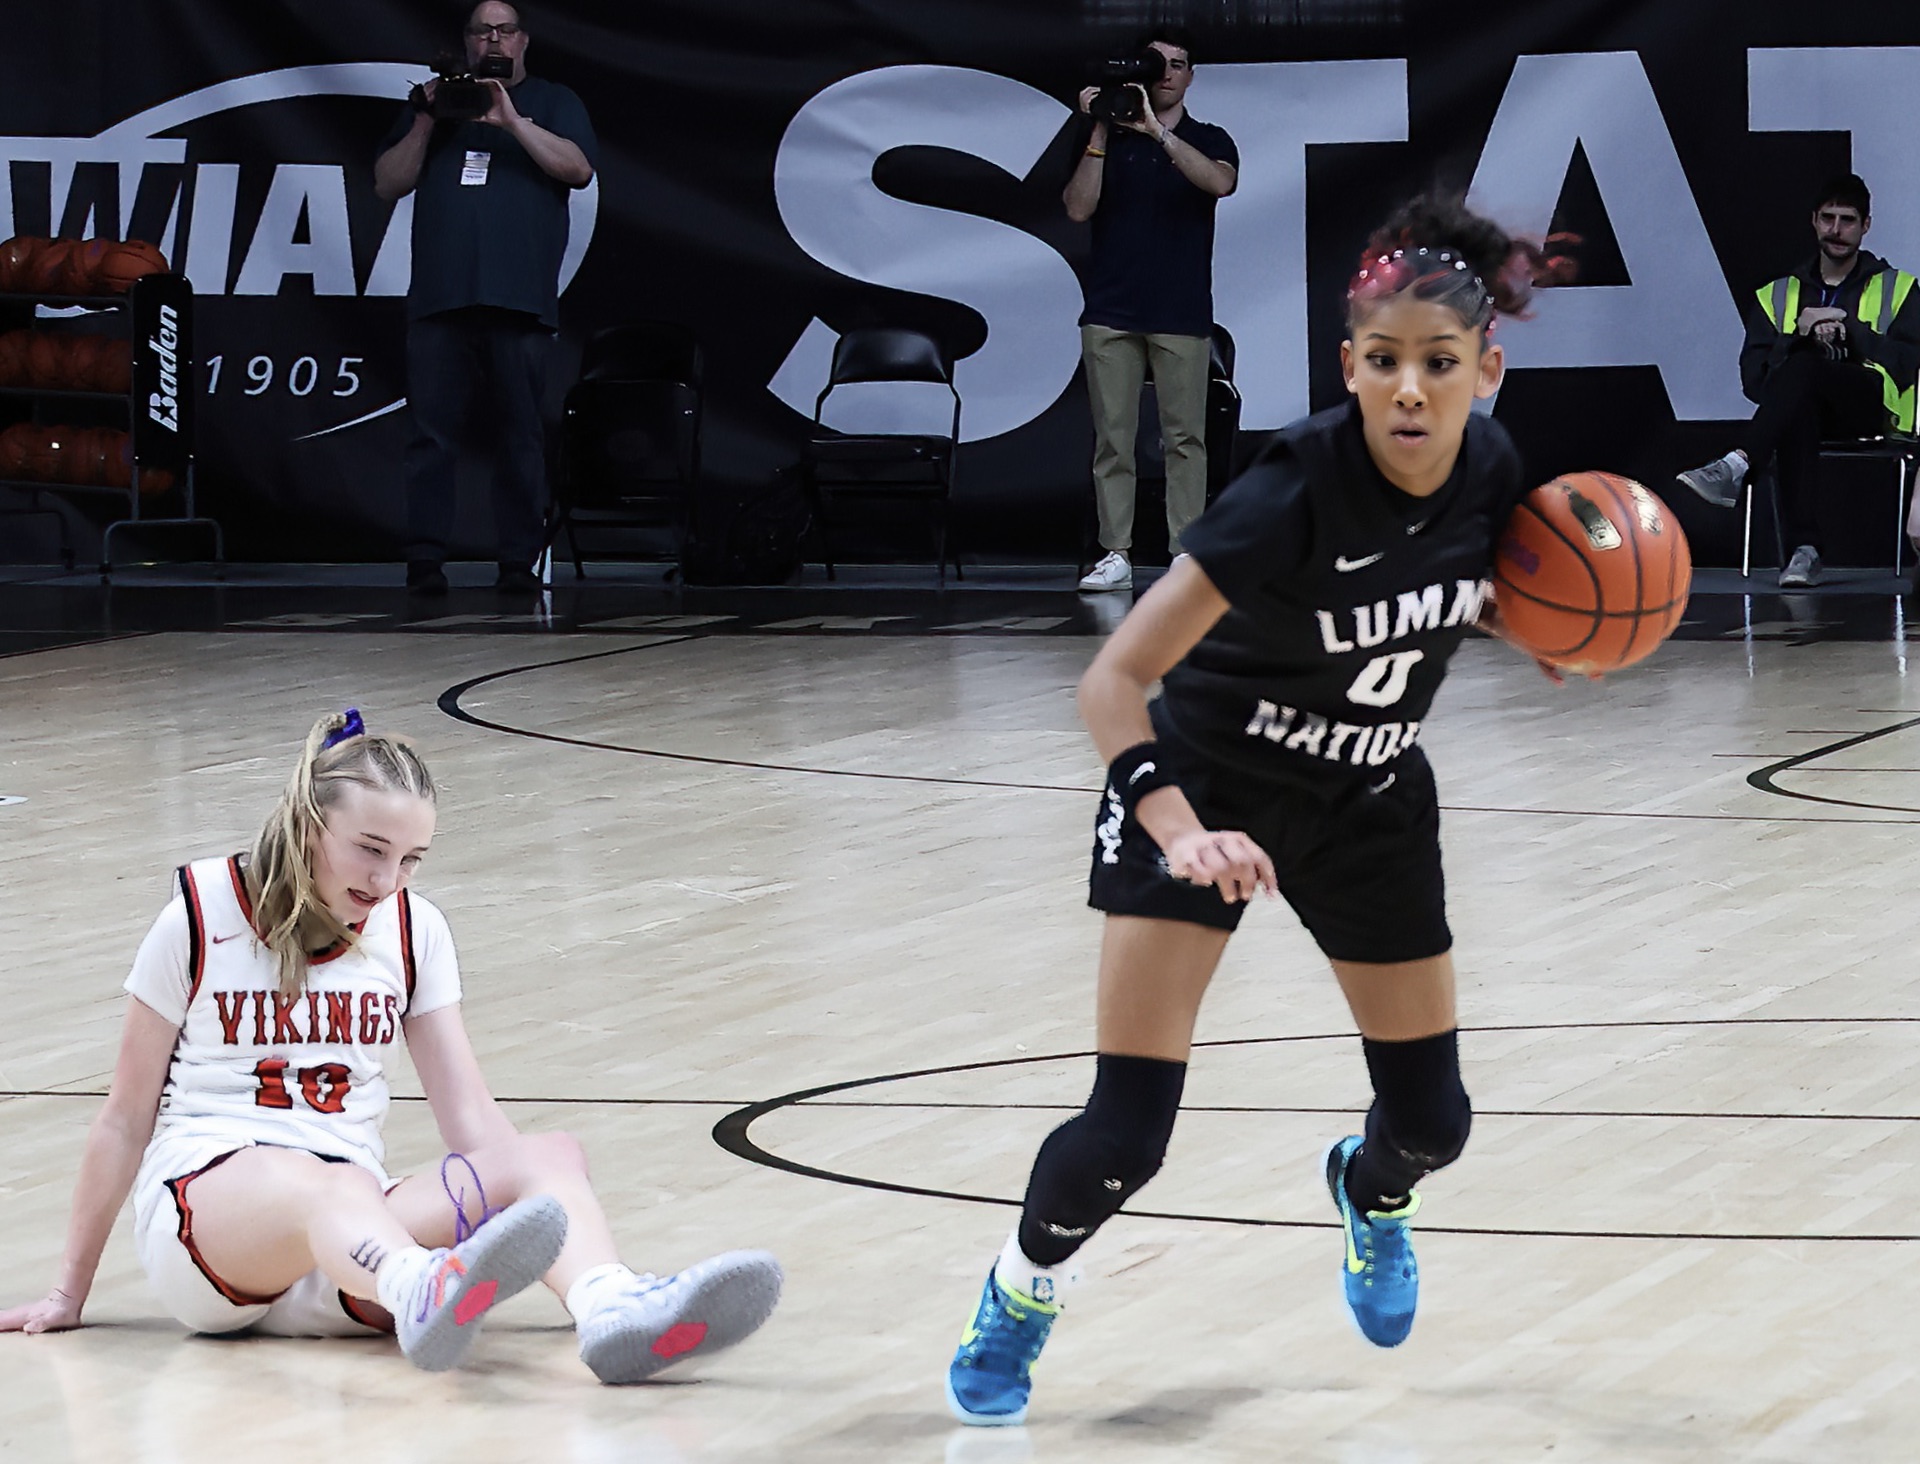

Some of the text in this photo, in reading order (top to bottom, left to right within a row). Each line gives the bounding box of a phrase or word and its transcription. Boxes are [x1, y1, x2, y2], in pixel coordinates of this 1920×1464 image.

[148, 304, 179, 432] Baden
[206, 355, 363, 397] 1905
[223, 612, 1074, 632] SPOKA
[1314, 578, 1490, 654] LUMM
[1346, 649, 1424, 708] 0
[213, 990, 398, 1046] VIKINGS
[252, 1055, 352, 1114] 10
